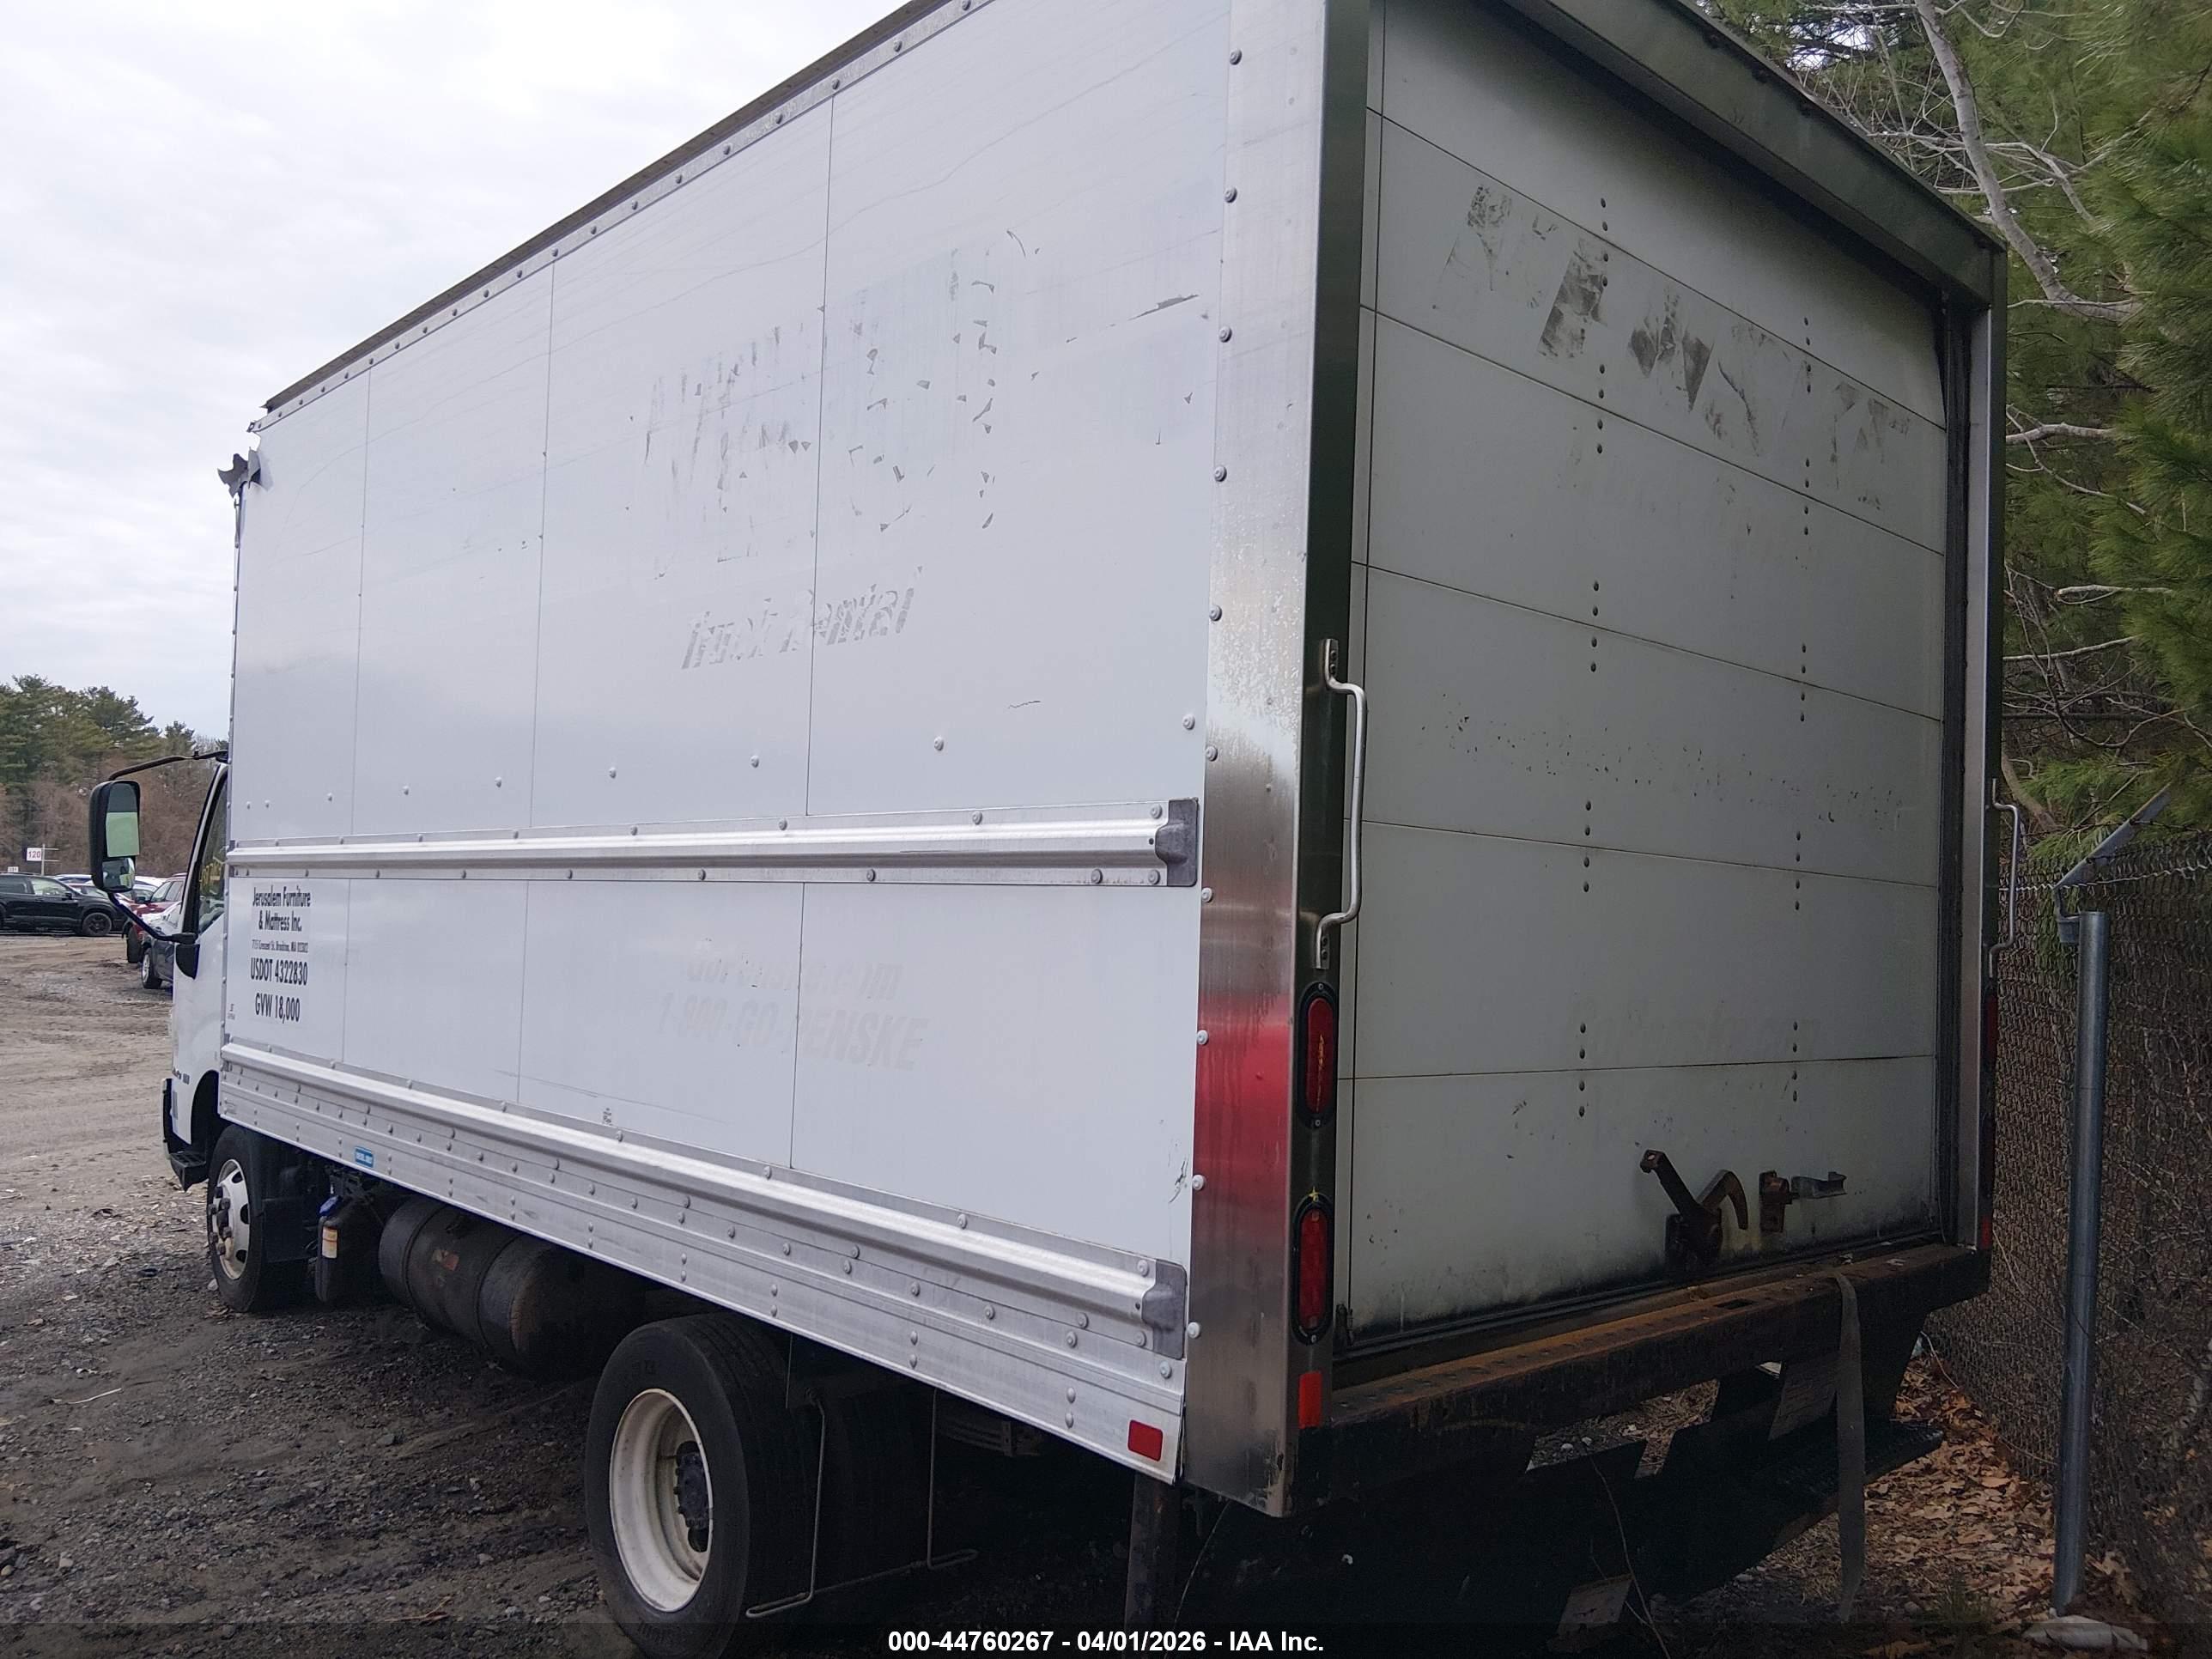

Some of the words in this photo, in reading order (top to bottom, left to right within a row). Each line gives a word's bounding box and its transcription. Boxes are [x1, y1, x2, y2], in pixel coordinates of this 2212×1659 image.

[252, 884, 281, 907] Jerusalem
[283, 884, 311, 907] Furniture
[258, 910, 263, 929] &
[264, 910, 289, 931] Mattress
[291, 910, 302, 932] Inc.
[251, 957, 273, 981] USDOT
[275, 959, 307, 986] 4322830
[255, 993, 273, 1017] GVW
[275, 995, 301, 1024] 18,000
